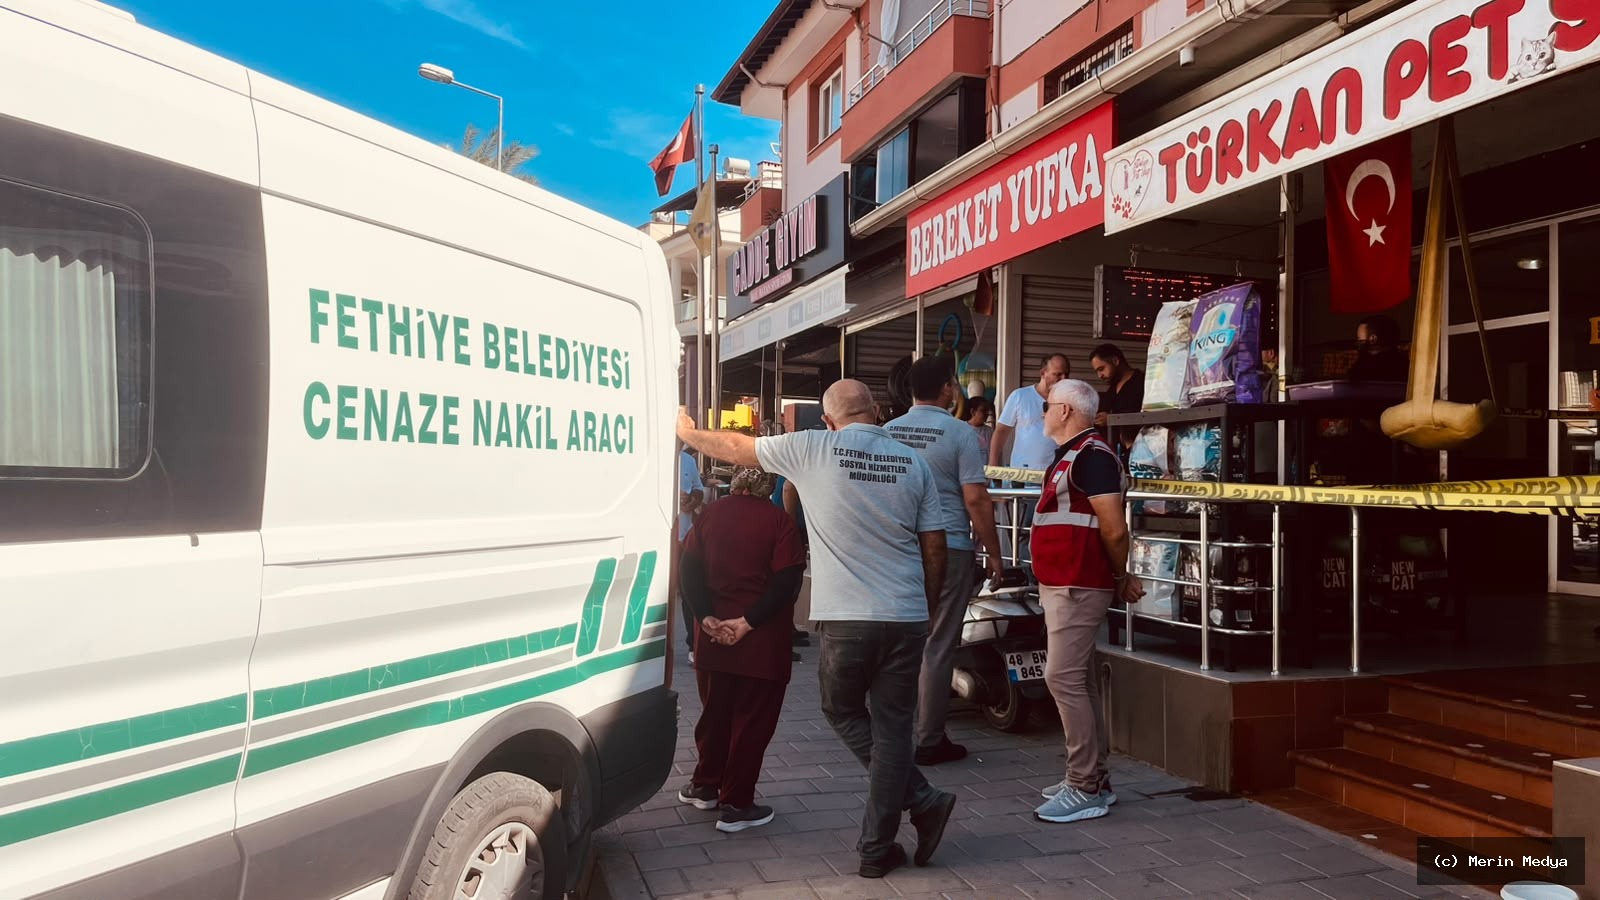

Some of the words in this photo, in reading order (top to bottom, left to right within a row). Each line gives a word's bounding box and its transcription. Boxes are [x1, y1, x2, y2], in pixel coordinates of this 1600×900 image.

[1158, 67, 1363, 203] TÜRKAN
[1383, 0, 1525, 121] PET
[909, 181, 1002, 277] BEREKET
[1006, 133, 1103, 233] YUFKA
[733, 228, 770, 297] CADDE
[775, 194, 817, 271] GİYİM
[309, 287, 471, 366] FETHİYE
[483, 322, 630, 390] BELEDİYESİ
[1194, 333, 1227, 350] KING
[303, 381, 460, 446] CENAZE
[473, 399, 558, 450] NAKİL
[567, 409, 634, 454] ARACI
[839, 459, 867, 471] SOSYAL
[868, 462, 907, 474] HİZMETLER
[874, 453, 913, 465] BELEDİYESİ
[849, 471, 897, 484] MÜDÜRLÜĞÜ
[1323, 557, 1346, 572] NEW
[1391, 560, 1416, 575] NEW
[1323, 572, 1347, 589] CAT
[1391, 575, 1416, 591] CAT
[1009, 654, 1023, 667] 48
[1021, 665, 1043, 679] 845
